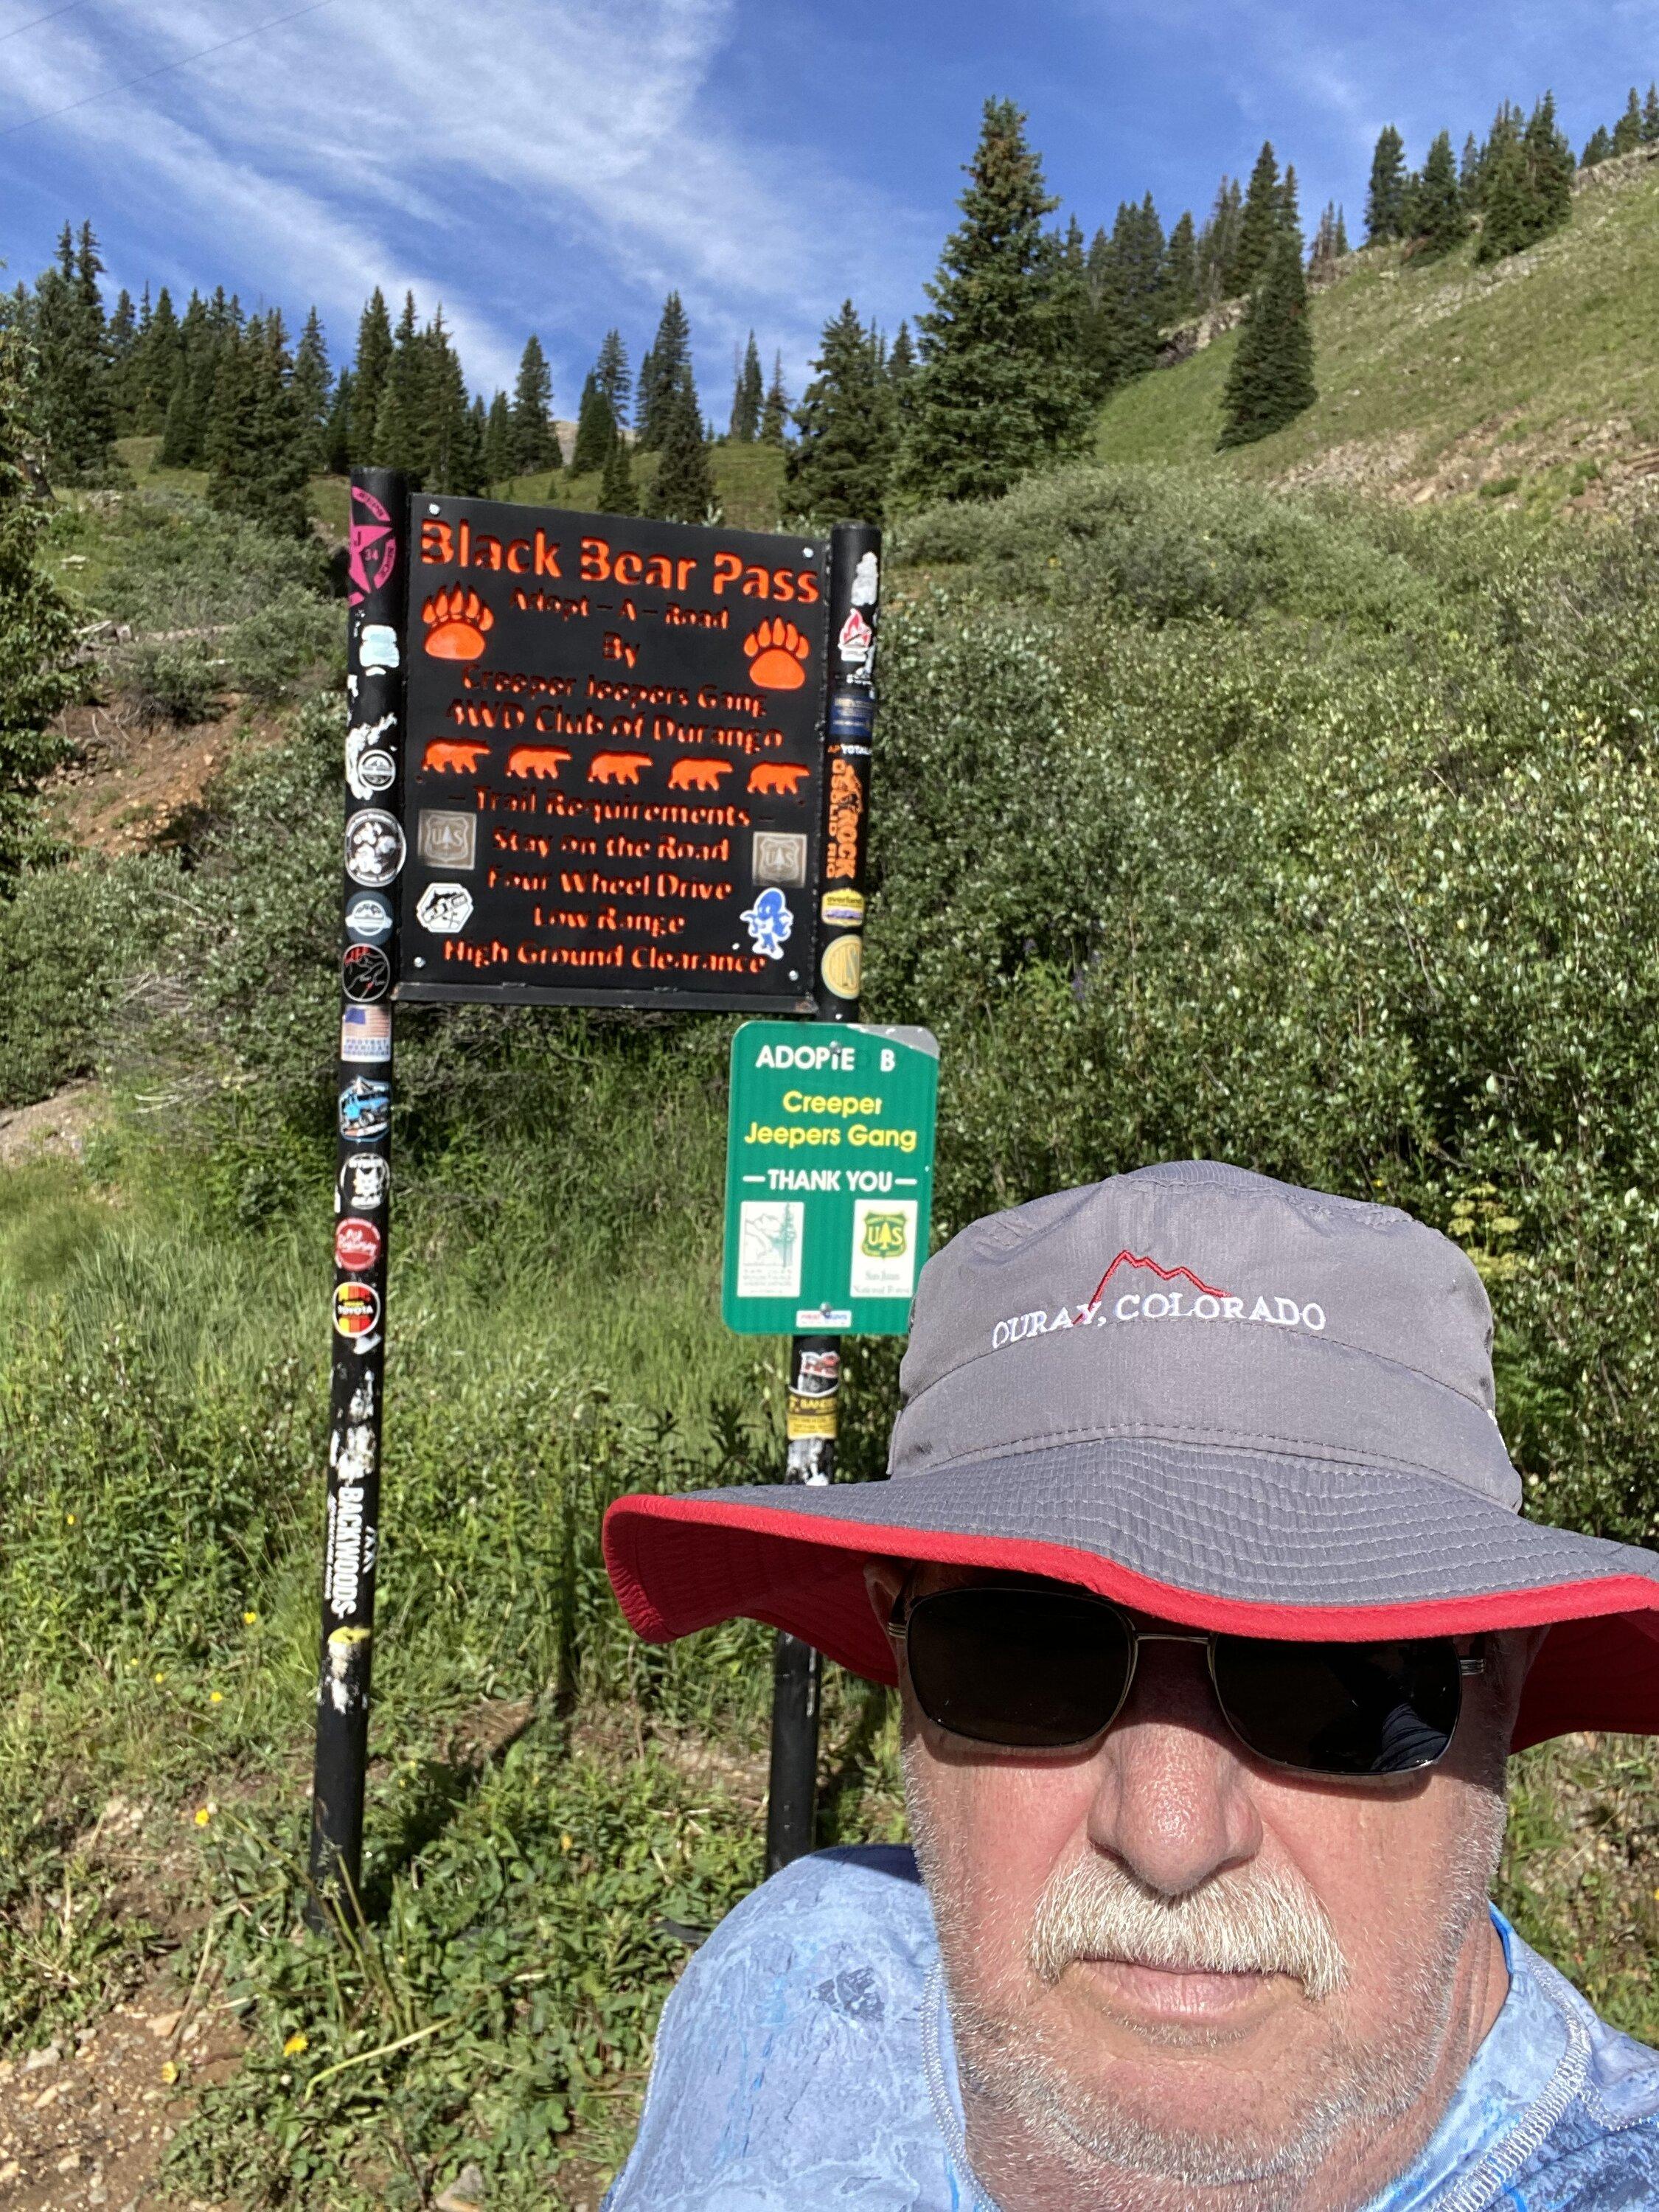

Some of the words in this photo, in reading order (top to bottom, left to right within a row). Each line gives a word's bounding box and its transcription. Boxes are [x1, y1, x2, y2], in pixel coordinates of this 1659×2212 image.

[421, 518, 562, 578] Black
[580, 536, 697, 591] Bear
[712, 552, 821, 603] Pass
[509, 587, 588, 621] Adopt
[666, 602, 729, 629] Road
[602, 631, 640, 668] By
[462, 664, 577, 700] Creeper
[586, 674, 688, 709] Jeepers
[698, 684, 767, 718] Gang
[535, 704, 605, 735] Club
[611, 711, 645, 739] of
[653, 714, 784, 755] Durango
[473, 785, 537, 813] Trail
[547, 787, 751, 826] Requirements
[493, 826, 553, 858] Stay
[560, 834, 597, 855] on
[606, 832, 652, 858] the
[657, 832, 730, 861] Road
[487, 863, 552, 891] Four
[560, 868, 651, 897] Wheel
[657, 871, 732, 900] Drive
[534, 902, 589, 929] Low
[598, 903, 686, 938] Range
[444, 939, 510, 968] High
[517, 939, 625, 968] Ground
[630, 943, 767, 975] Clearance
[782, 1091, 883, 1118] Creeper
[744, 1122, 841, 1149] Jeepers
[848, 1124, 918, 1152] Gang
[768, 1169, 841, 1192] THANK
[846, 1171, 893, 1192] YOU
[991, 1300, 1106, 1349] OURAY,
[1116, 1292, 1327, 1331] COLORADO
[330, 1486, 365, 1617] BACKWOODS
